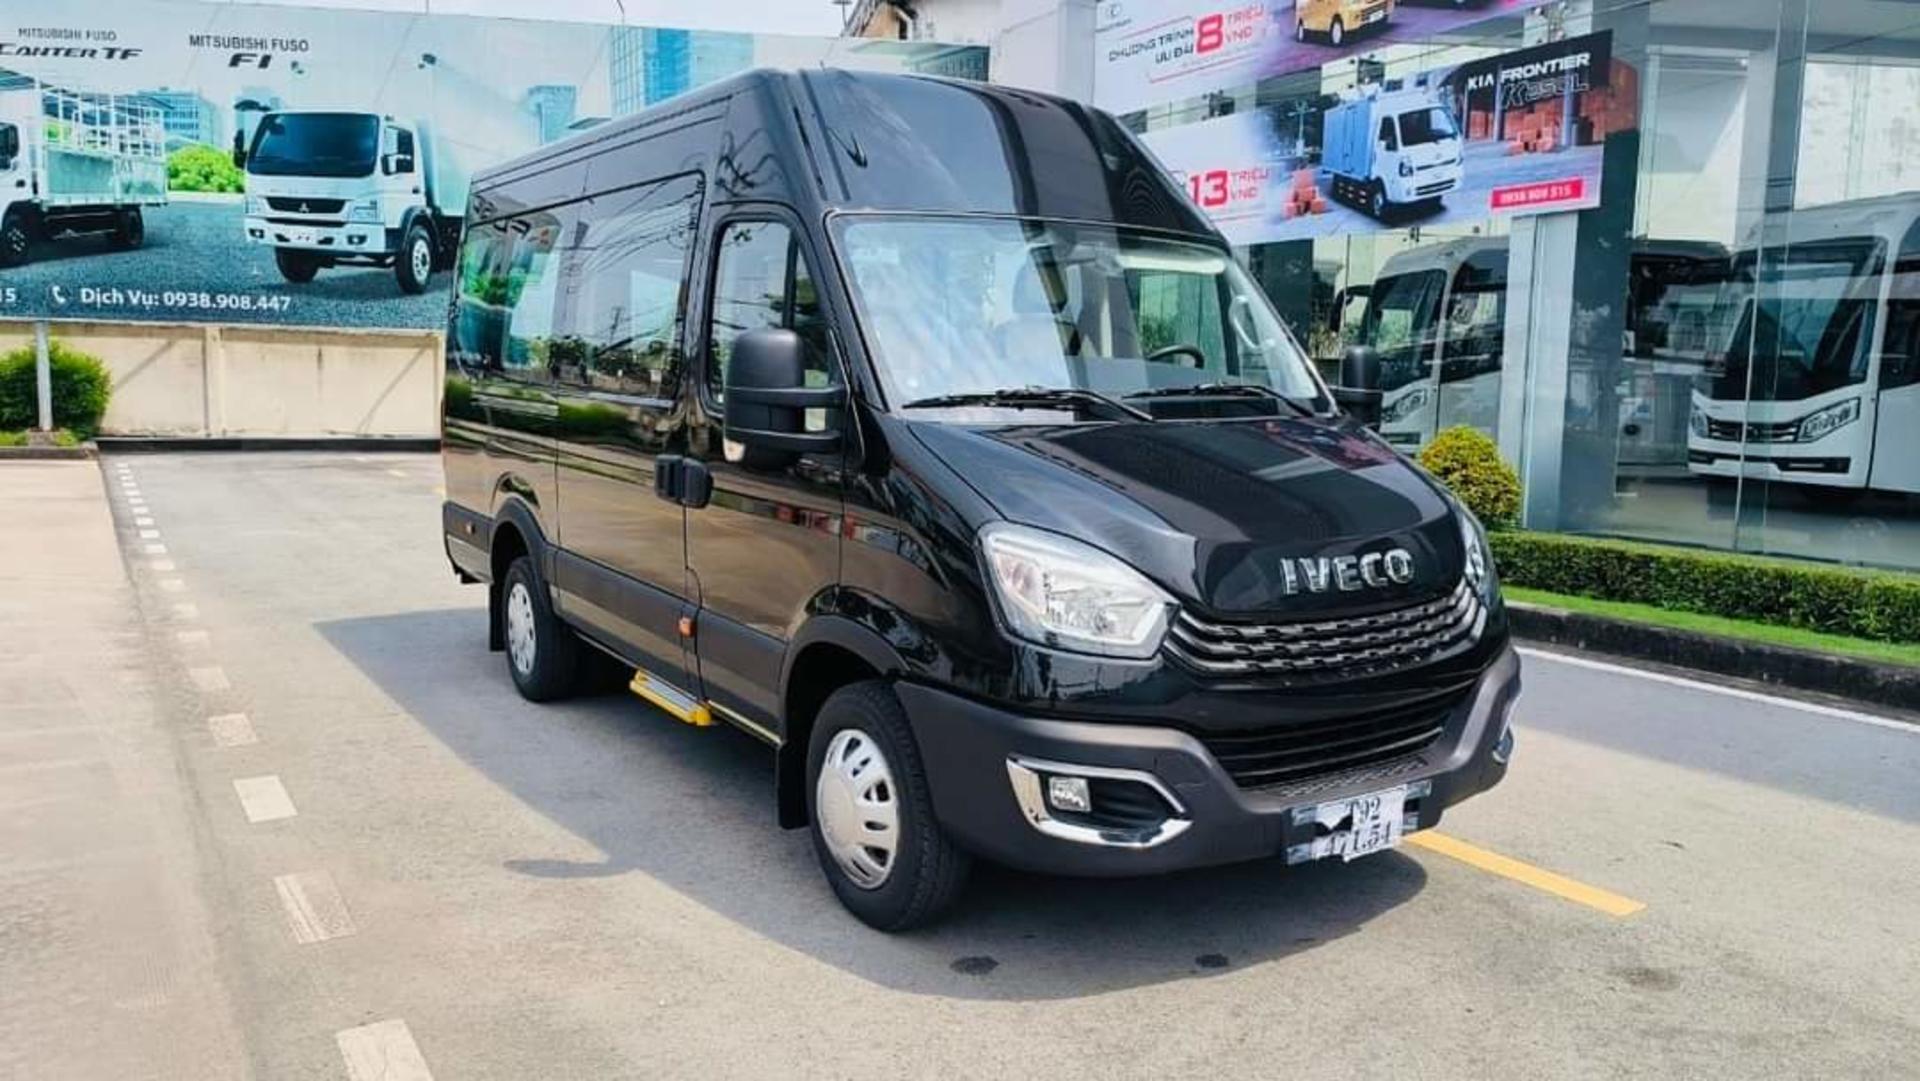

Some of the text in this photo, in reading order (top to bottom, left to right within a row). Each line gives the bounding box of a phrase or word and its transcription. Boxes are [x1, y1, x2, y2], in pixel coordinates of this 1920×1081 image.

[18, 27, 117, 41] MITSUBISHI FUSO
[189, 34, 309, 52] MITSUBISHI FUSO
[1196, 13, 1223, 54] 8
[101, 46, 143, 60] TF
[1467, 52, 1590, 92] KIA FRONTIER
[1189, 169, 1228, 207] 13
[80, 287, 124, 309] Dịch
[163, 291, 291, 312] 0938.908.447
[1280, 547, 1414, 596] IVECO
